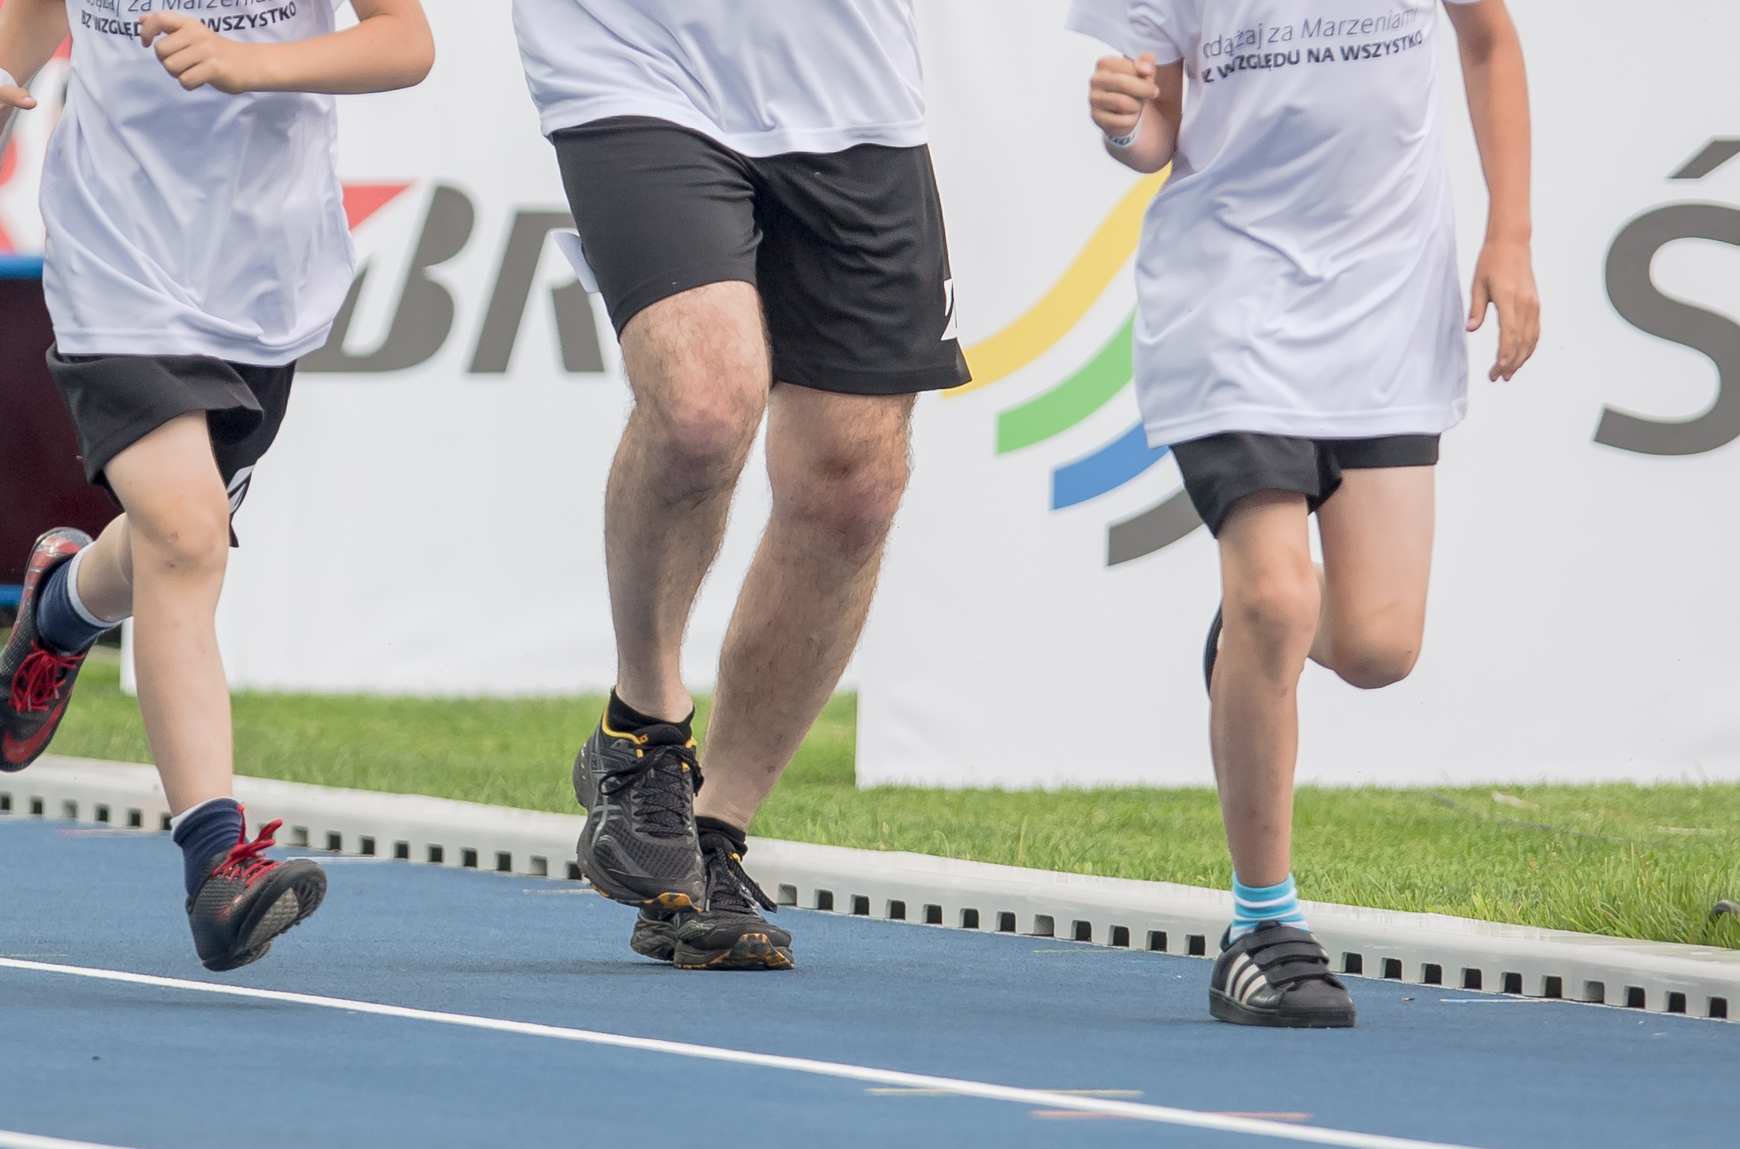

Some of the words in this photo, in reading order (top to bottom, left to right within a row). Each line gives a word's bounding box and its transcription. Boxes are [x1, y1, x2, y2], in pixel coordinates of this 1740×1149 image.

[1267, 25, 1293, 44] za
[1307, 48, 1335, 63] NA
[1340, 30, 1423, 61] WSZYSTKO
